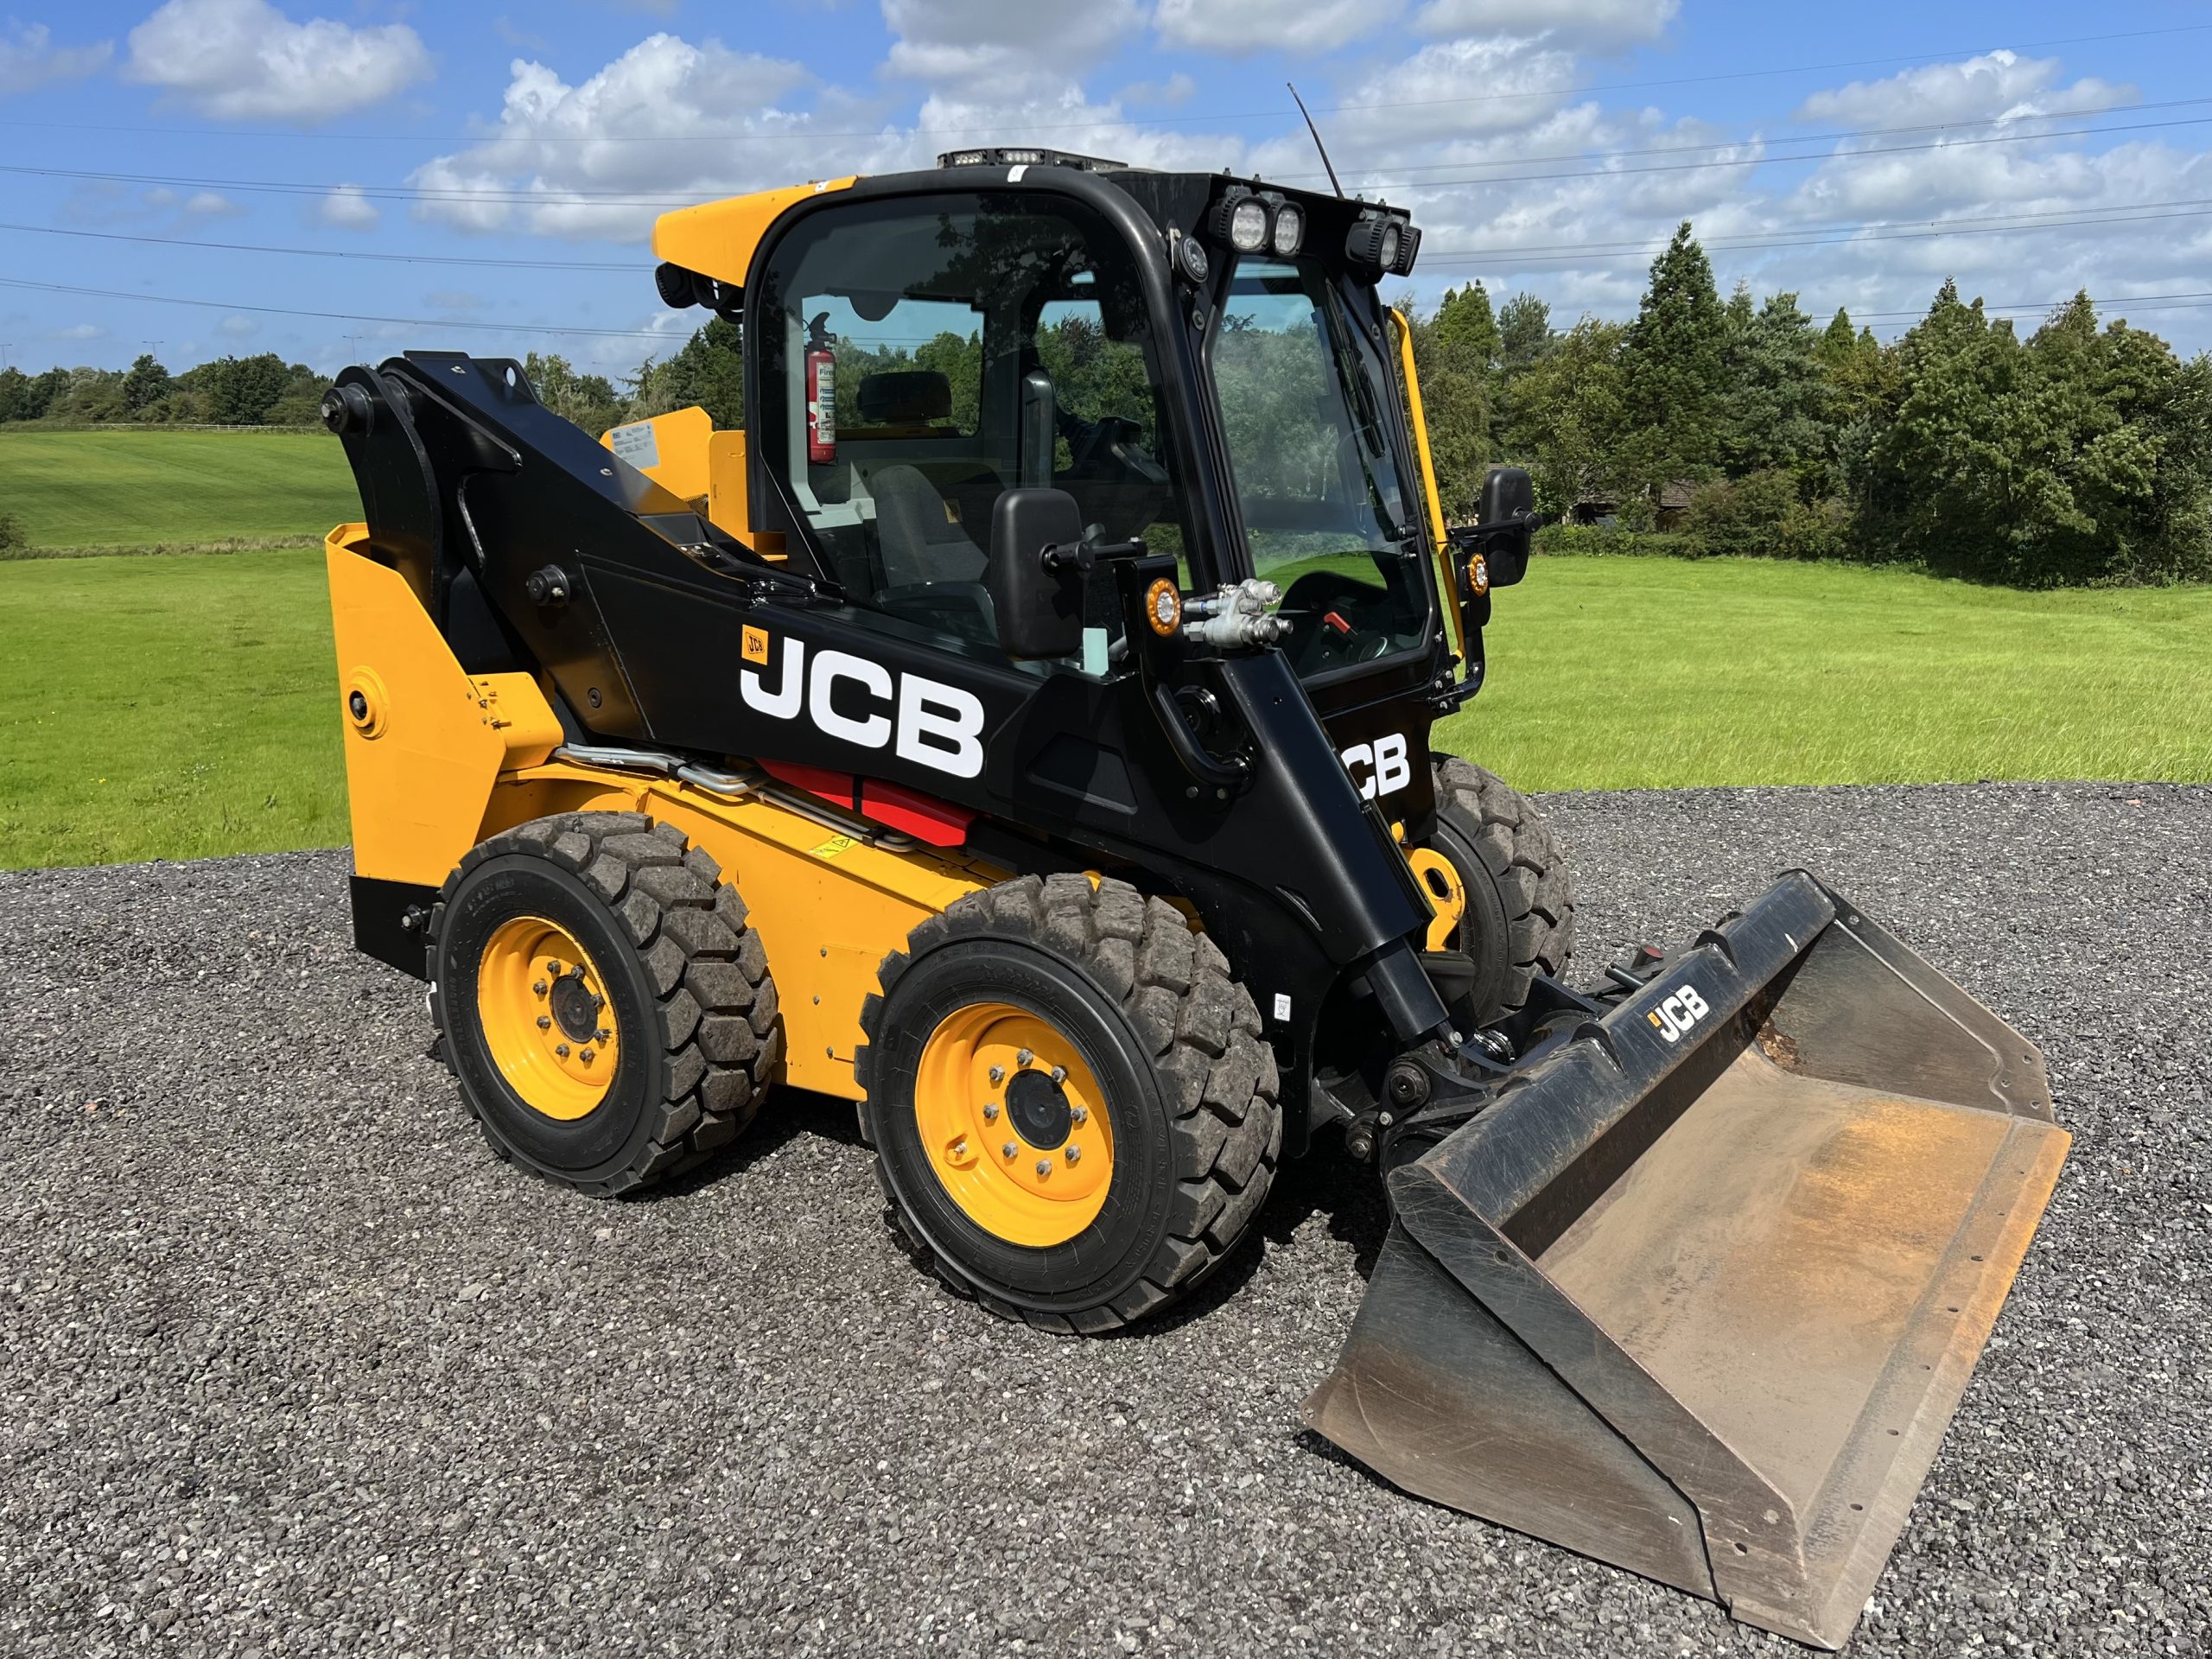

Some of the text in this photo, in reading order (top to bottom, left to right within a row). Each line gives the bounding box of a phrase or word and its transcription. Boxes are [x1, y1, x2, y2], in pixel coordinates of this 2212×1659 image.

[748, 635, 763, 652] JCB
[741, 636, 984, 779] JCB
[1340, 733, 1411, 800] CB
[1654, 984, 1710, 1043] JCB
